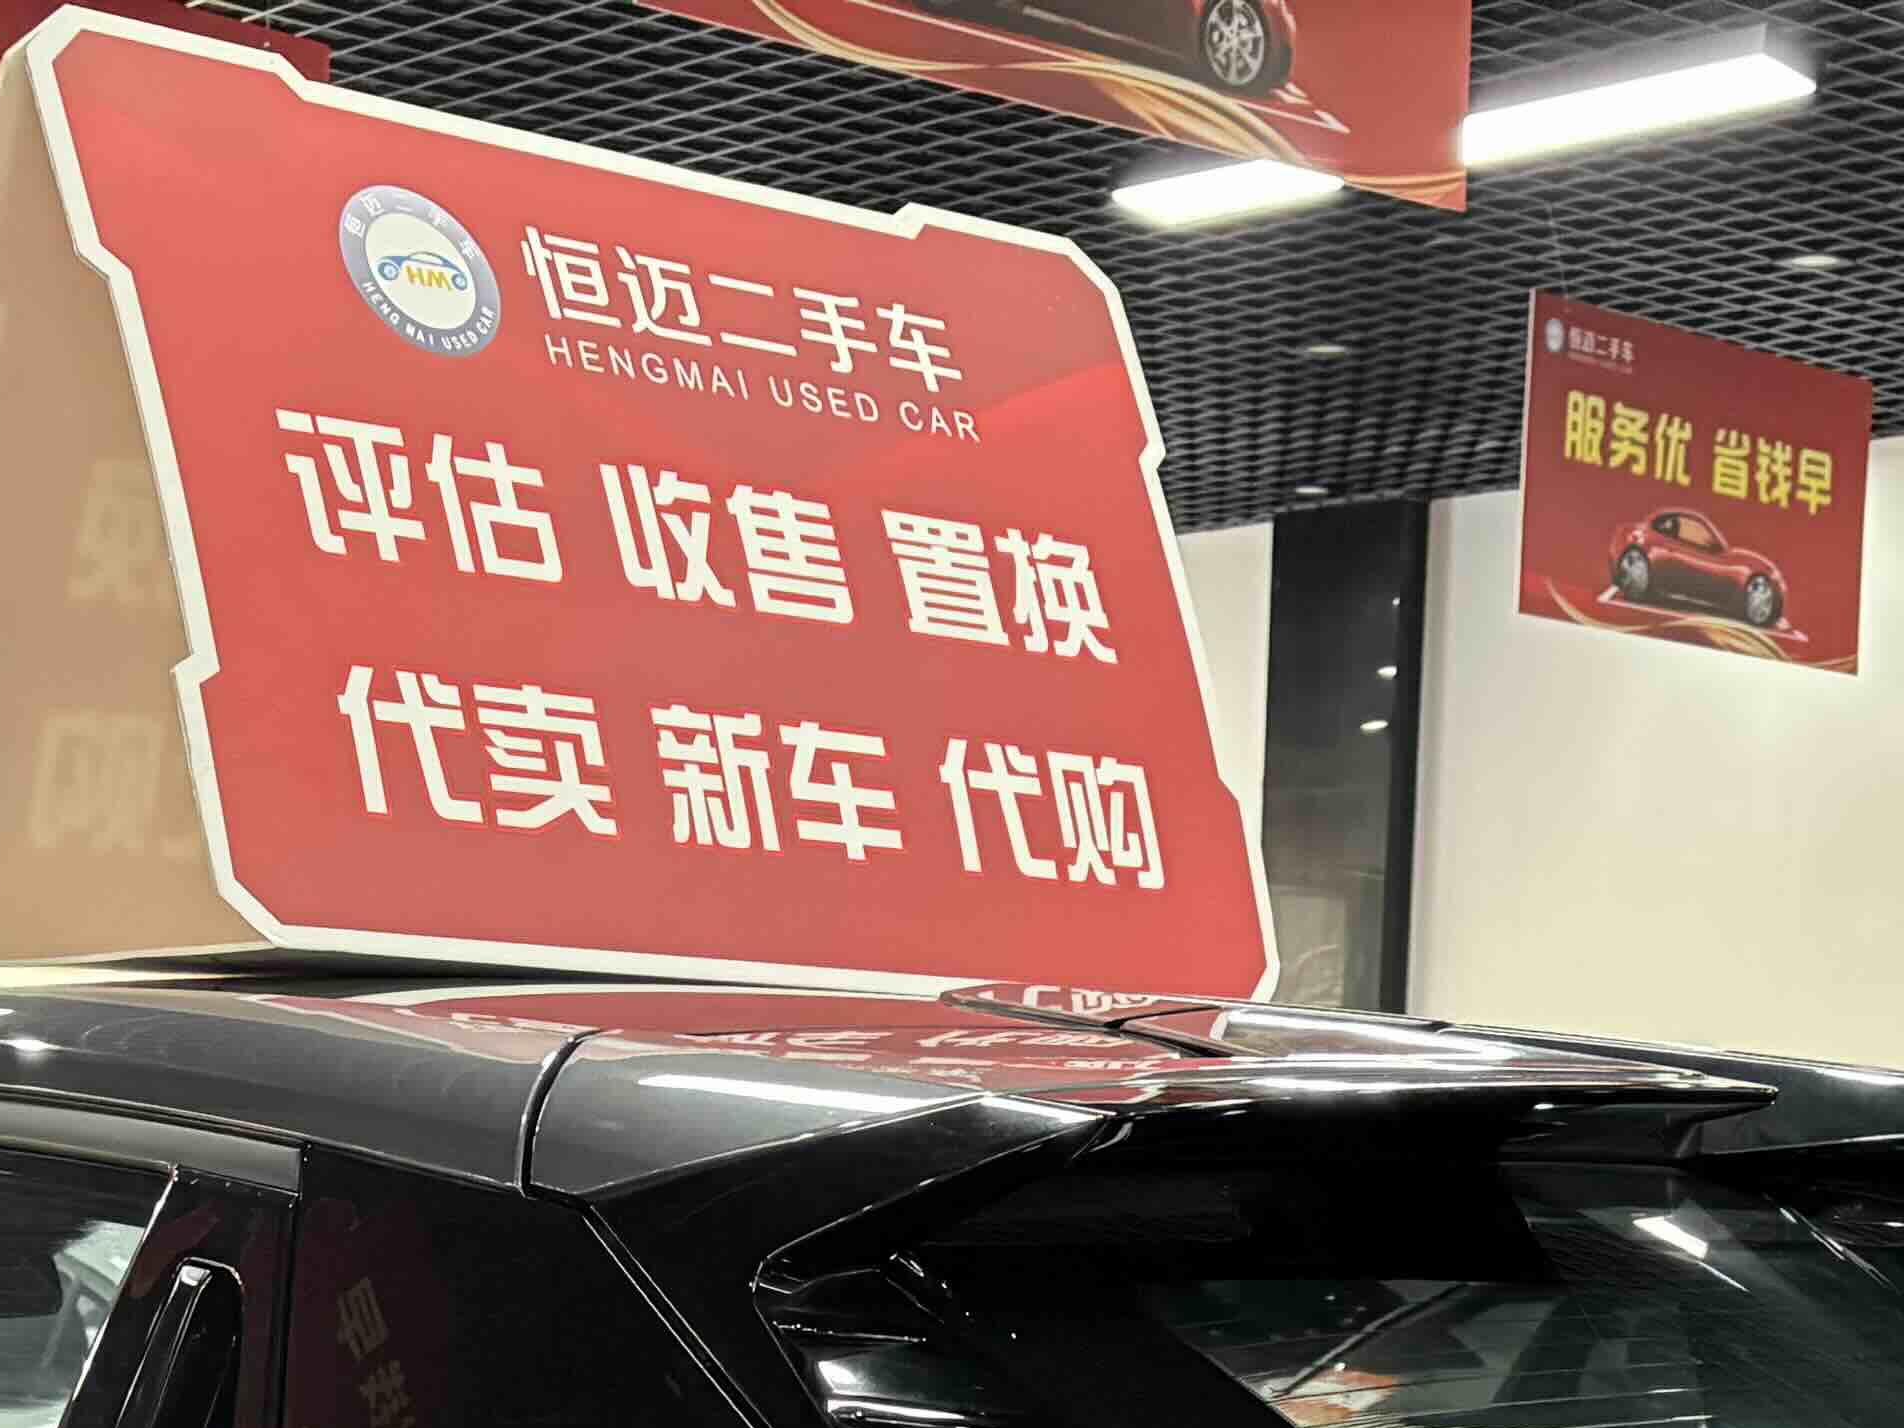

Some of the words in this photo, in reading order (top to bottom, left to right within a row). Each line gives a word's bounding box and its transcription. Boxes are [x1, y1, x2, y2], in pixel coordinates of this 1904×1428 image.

[521, 226, 963, 393] 恒迈二手车
[544, 334, 749, 400] HENGMAI
[768, 375, 879, 421] USED
[899, 400, 981, 442] CAR
[275, 408, 563, 583] 评估
[599, 464, 854, 624] 收售
[881, 509, 1117, 664] 置换
[1564, 391, 1693, 487] 服务优
[1712, 428, 1834, 515] 省钱早
[337, 665, 618, 836] 代卖
[650, 705, 904, 860] 新车
[939, 738, 1165, 889] 代购
